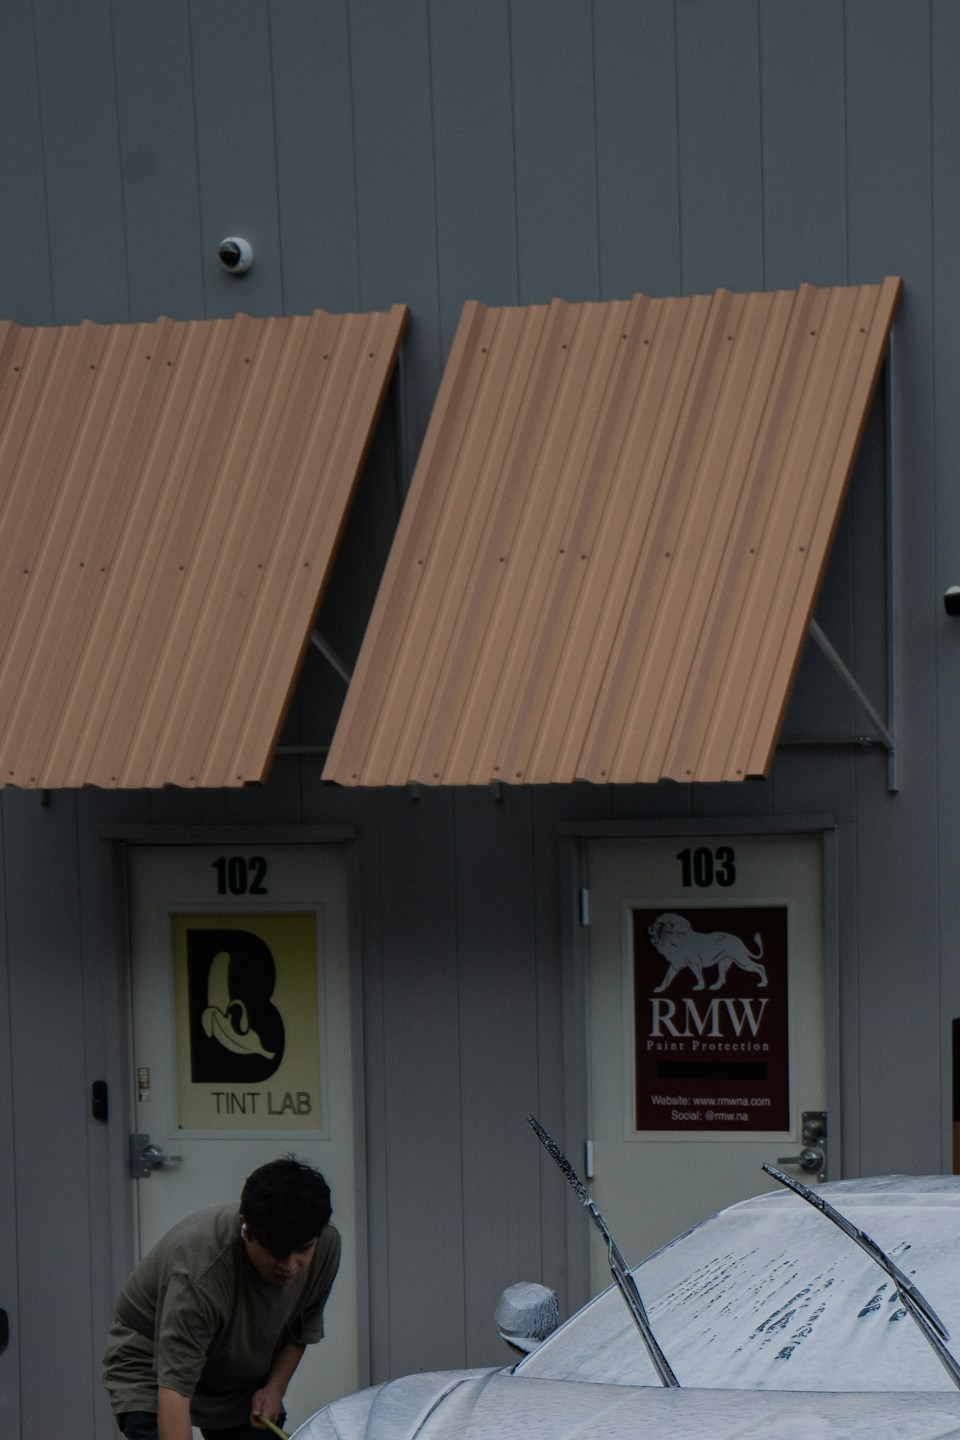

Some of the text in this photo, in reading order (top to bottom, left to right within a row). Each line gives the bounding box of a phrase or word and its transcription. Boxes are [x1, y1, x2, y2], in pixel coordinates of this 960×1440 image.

[212, 856, 267, 895] 102
[676, 847, 736, 887] 103
[648, 998, 769, 1037] RMW
[646, 1041, 770, 1051] Paint Protection
[212, 1092, 312, 1115] TINT LAB
[652, 1095, 771, 1107] Website: www.rmwna.com
[671, 1110, 749, 1122] Social: @rmw.na
